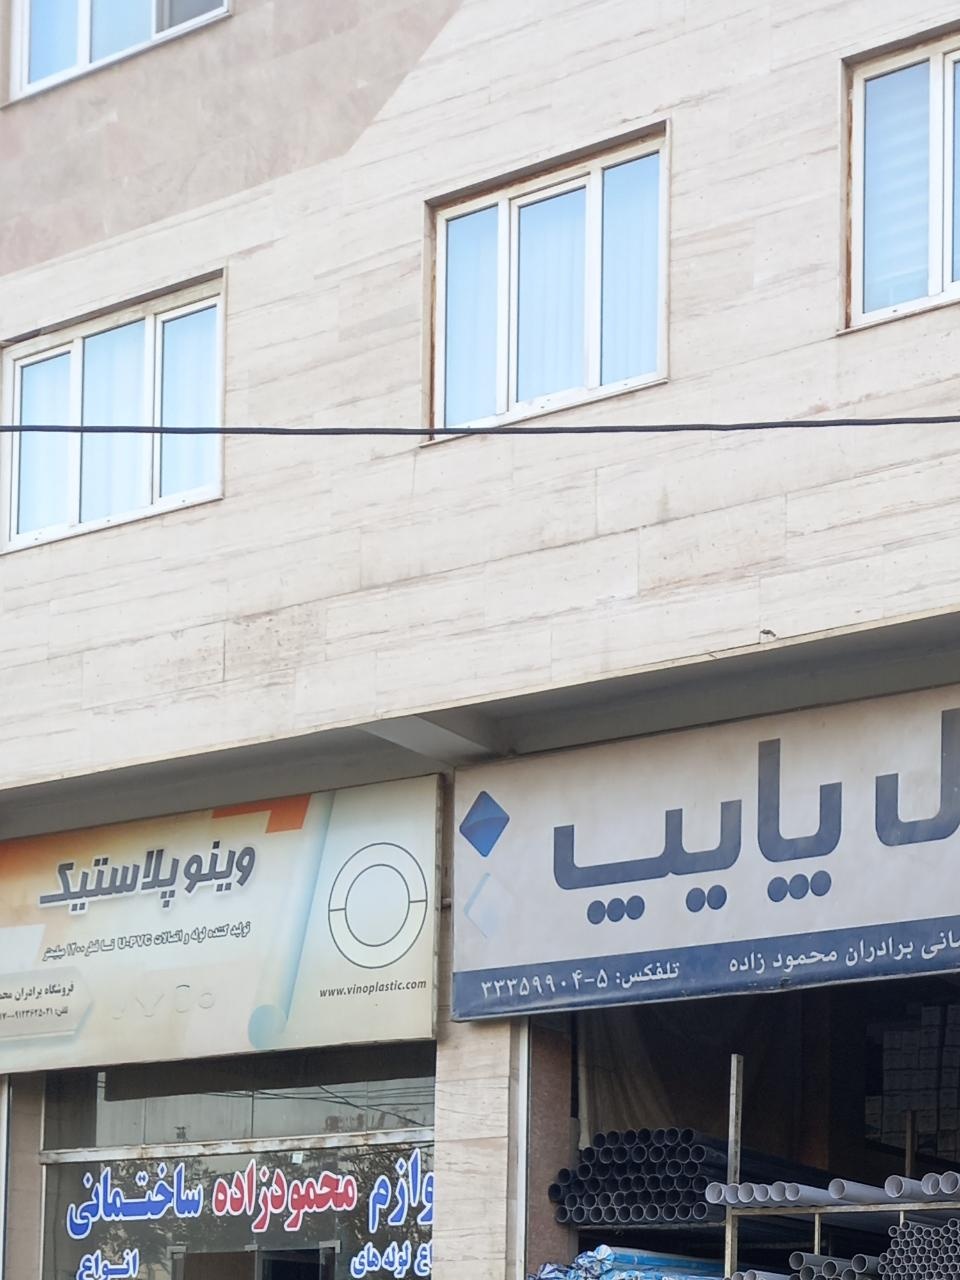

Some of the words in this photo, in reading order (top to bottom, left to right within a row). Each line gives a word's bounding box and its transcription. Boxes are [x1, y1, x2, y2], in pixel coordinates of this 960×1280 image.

[553, 738, 843, 925] پایپ
[616, 960, 681, 989] تلفکس:
[845, 938, 914, 968] برادران
[319, 980, 427, 998] www.vinoplastic.com
[67, 1162, 203, 1239] ساختمانی
[369, 1148, 434, 1233] وازم
